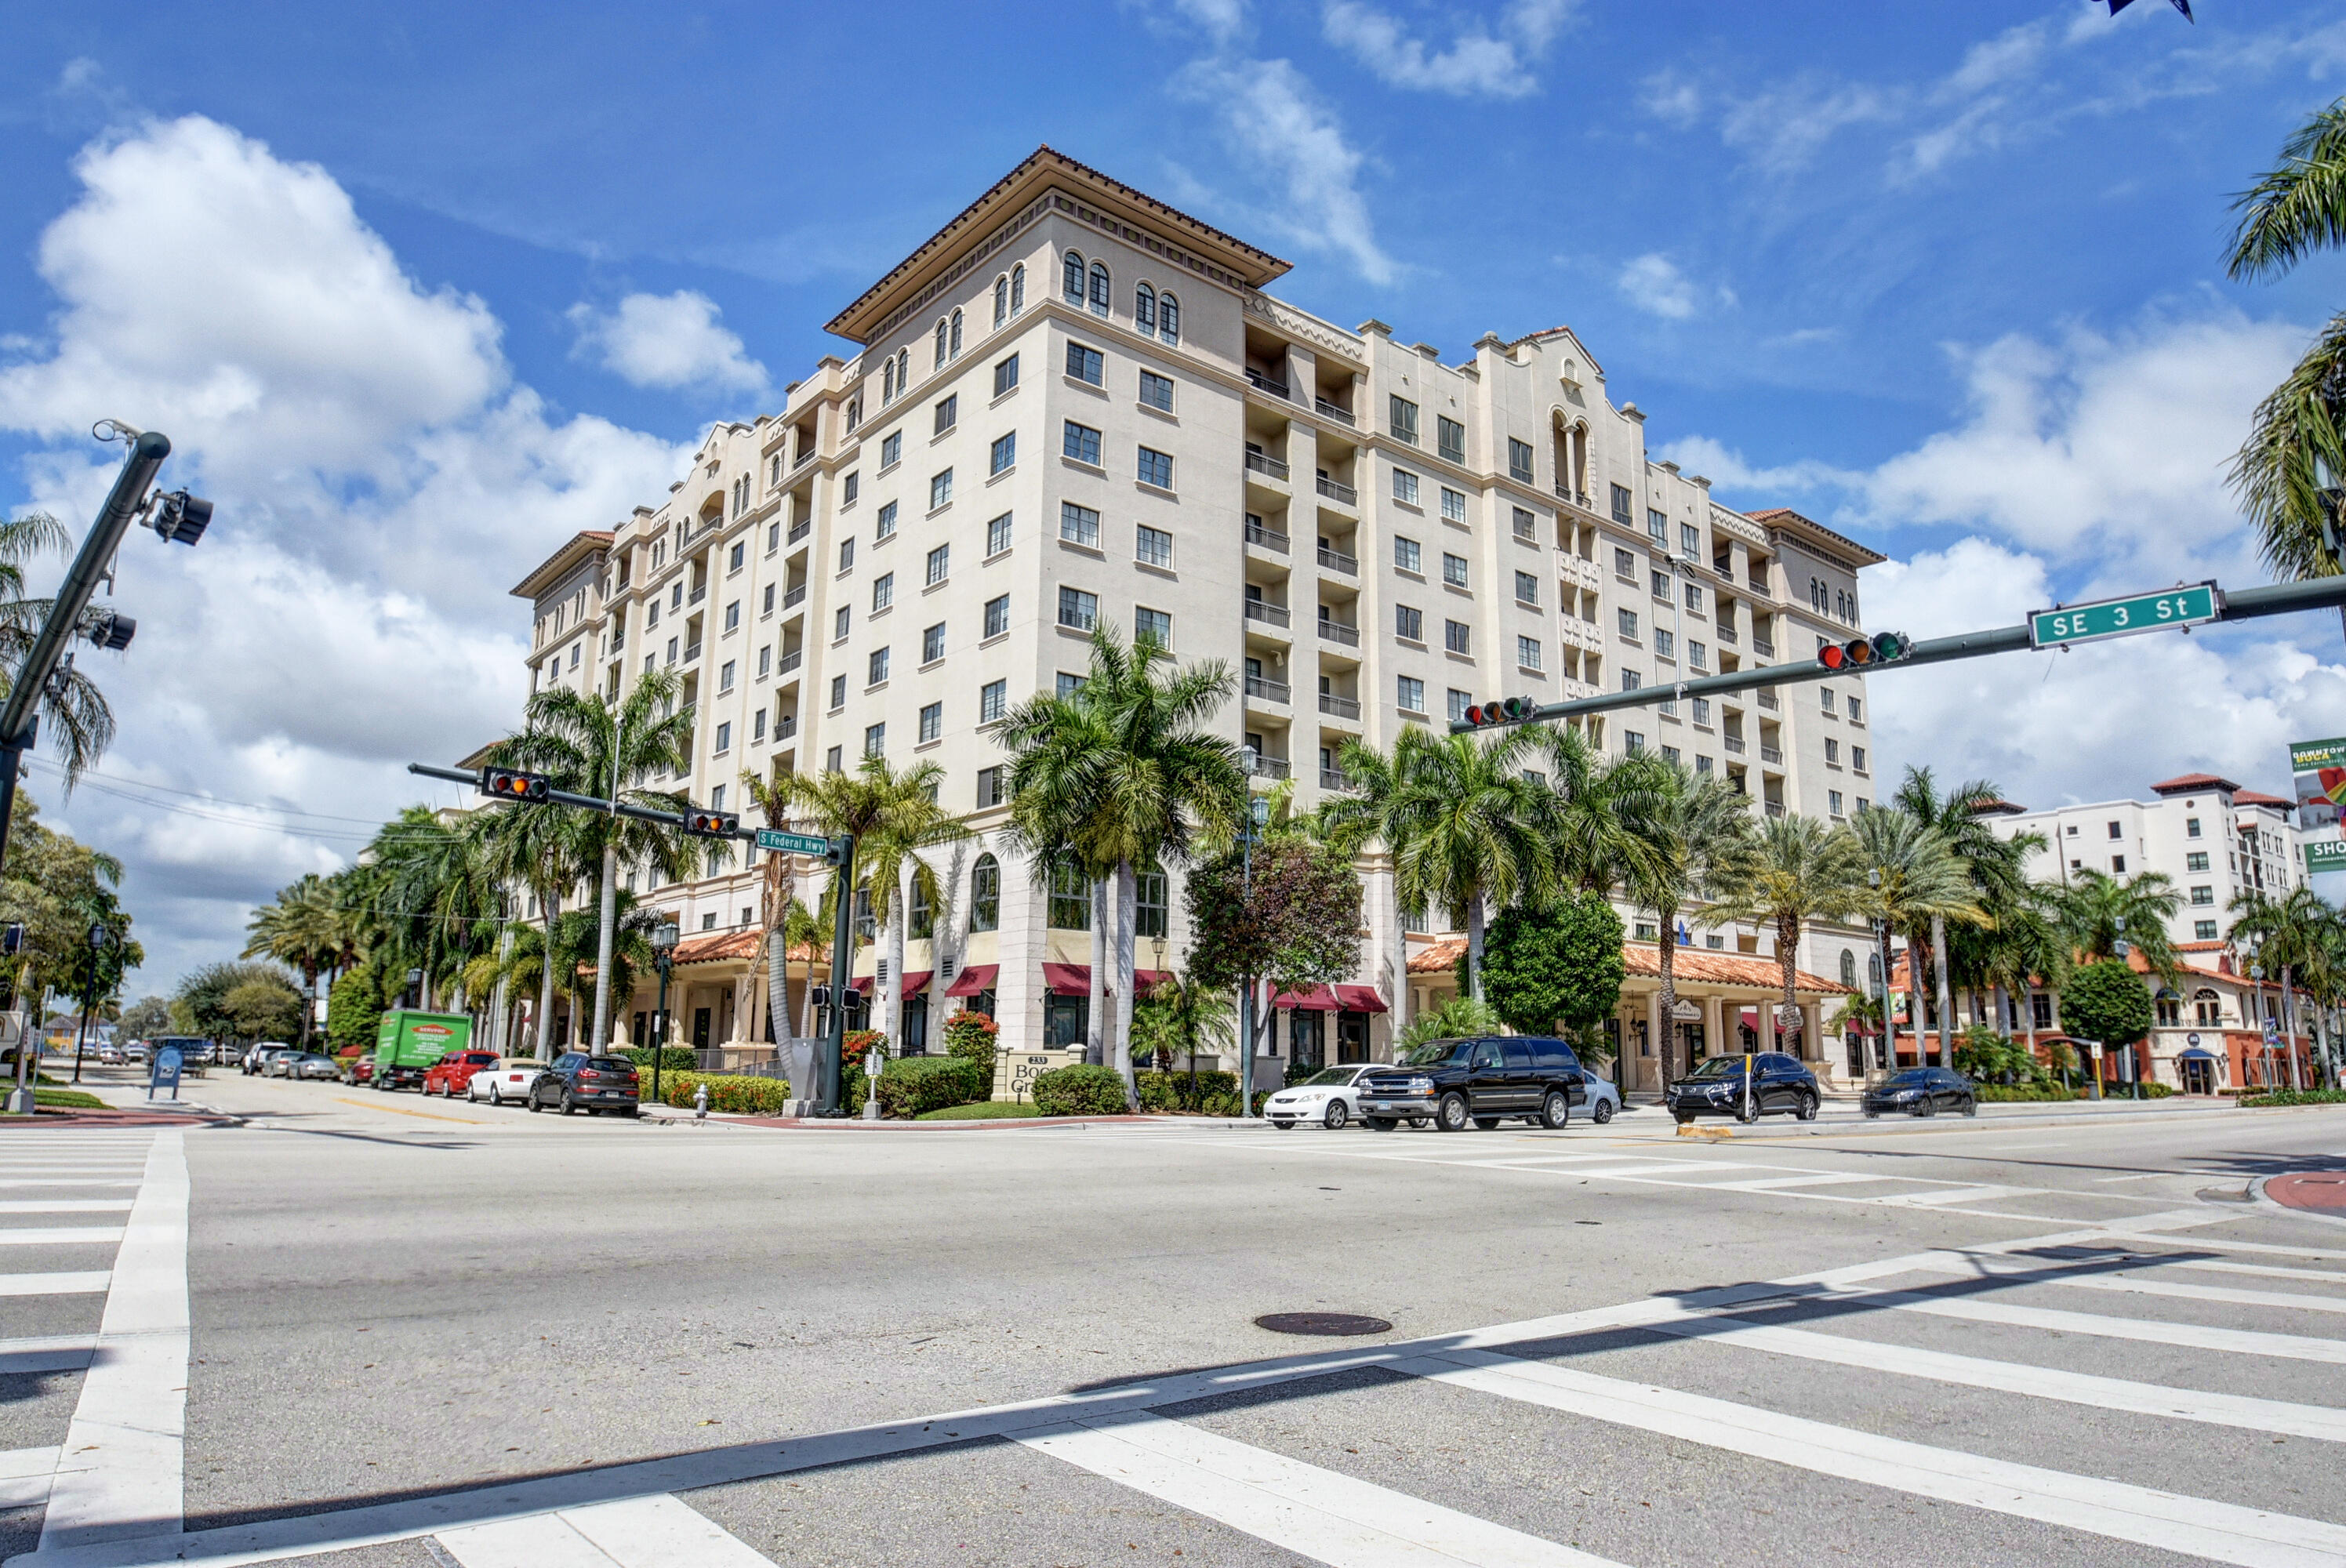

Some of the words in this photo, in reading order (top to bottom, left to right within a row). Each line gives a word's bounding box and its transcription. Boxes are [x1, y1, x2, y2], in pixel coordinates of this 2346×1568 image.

[2053, 613, 2088, 636] SE
[2113, 607, 2130, 626] 3
[2156, 597, 2188, 619] St
[2297, 753, 2330, 764] BOCA
[761, 833, 767, 844] S
[770, 834, 801, 849] Federal
[805, 839, 824, 854] Hwy
